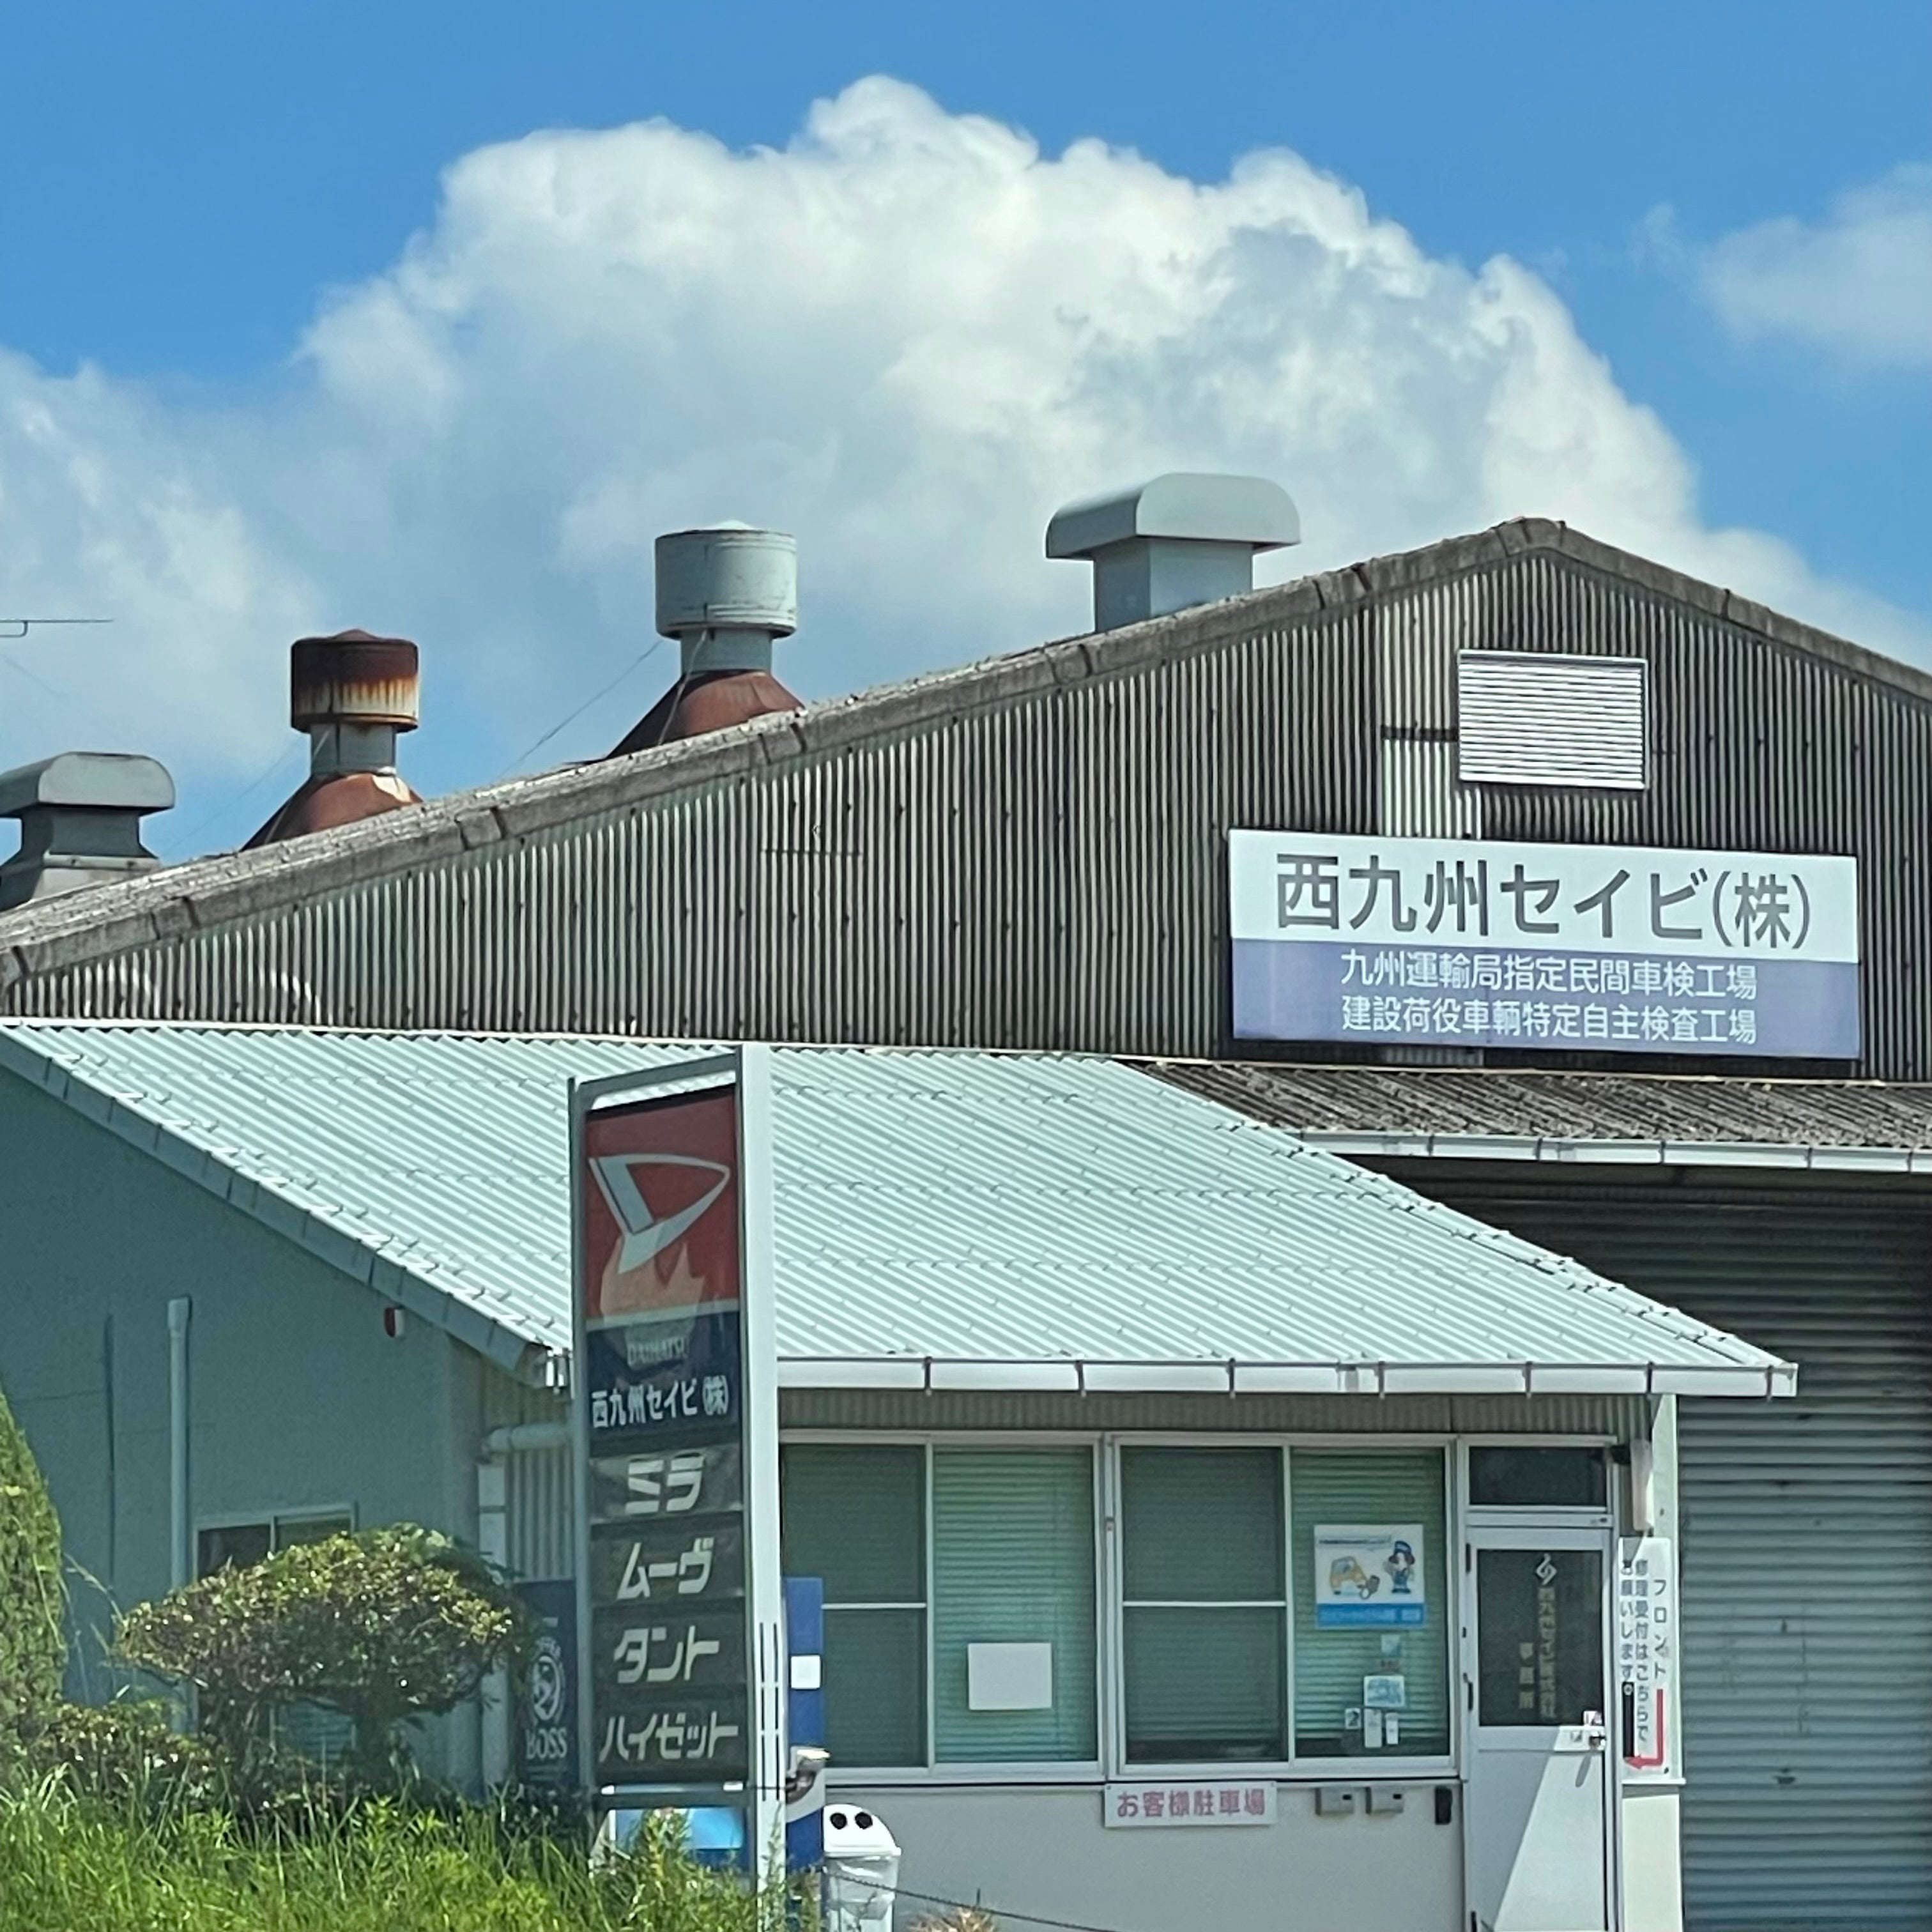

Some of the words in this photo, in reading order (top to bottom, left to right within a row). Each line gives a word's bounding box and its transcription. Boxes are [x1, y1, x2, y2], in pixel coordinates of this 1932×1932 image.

[1276, 853, 1811, 950] 西九州セイビ(株)
[1340, 948, 1757, 1000] 九州運輸局指定民間車検工場
[625, 1455, 704, 1514] ミラ
[613, 1625, 720, 1683] タント
[1653, 1579, 1667, 1679] フロント
[525, 1727, 567, 1760] BOSS
[598, 1710, 739, 1763] ハイゼット
[1117, 1789, 1266, 1818] お客様駐車場
